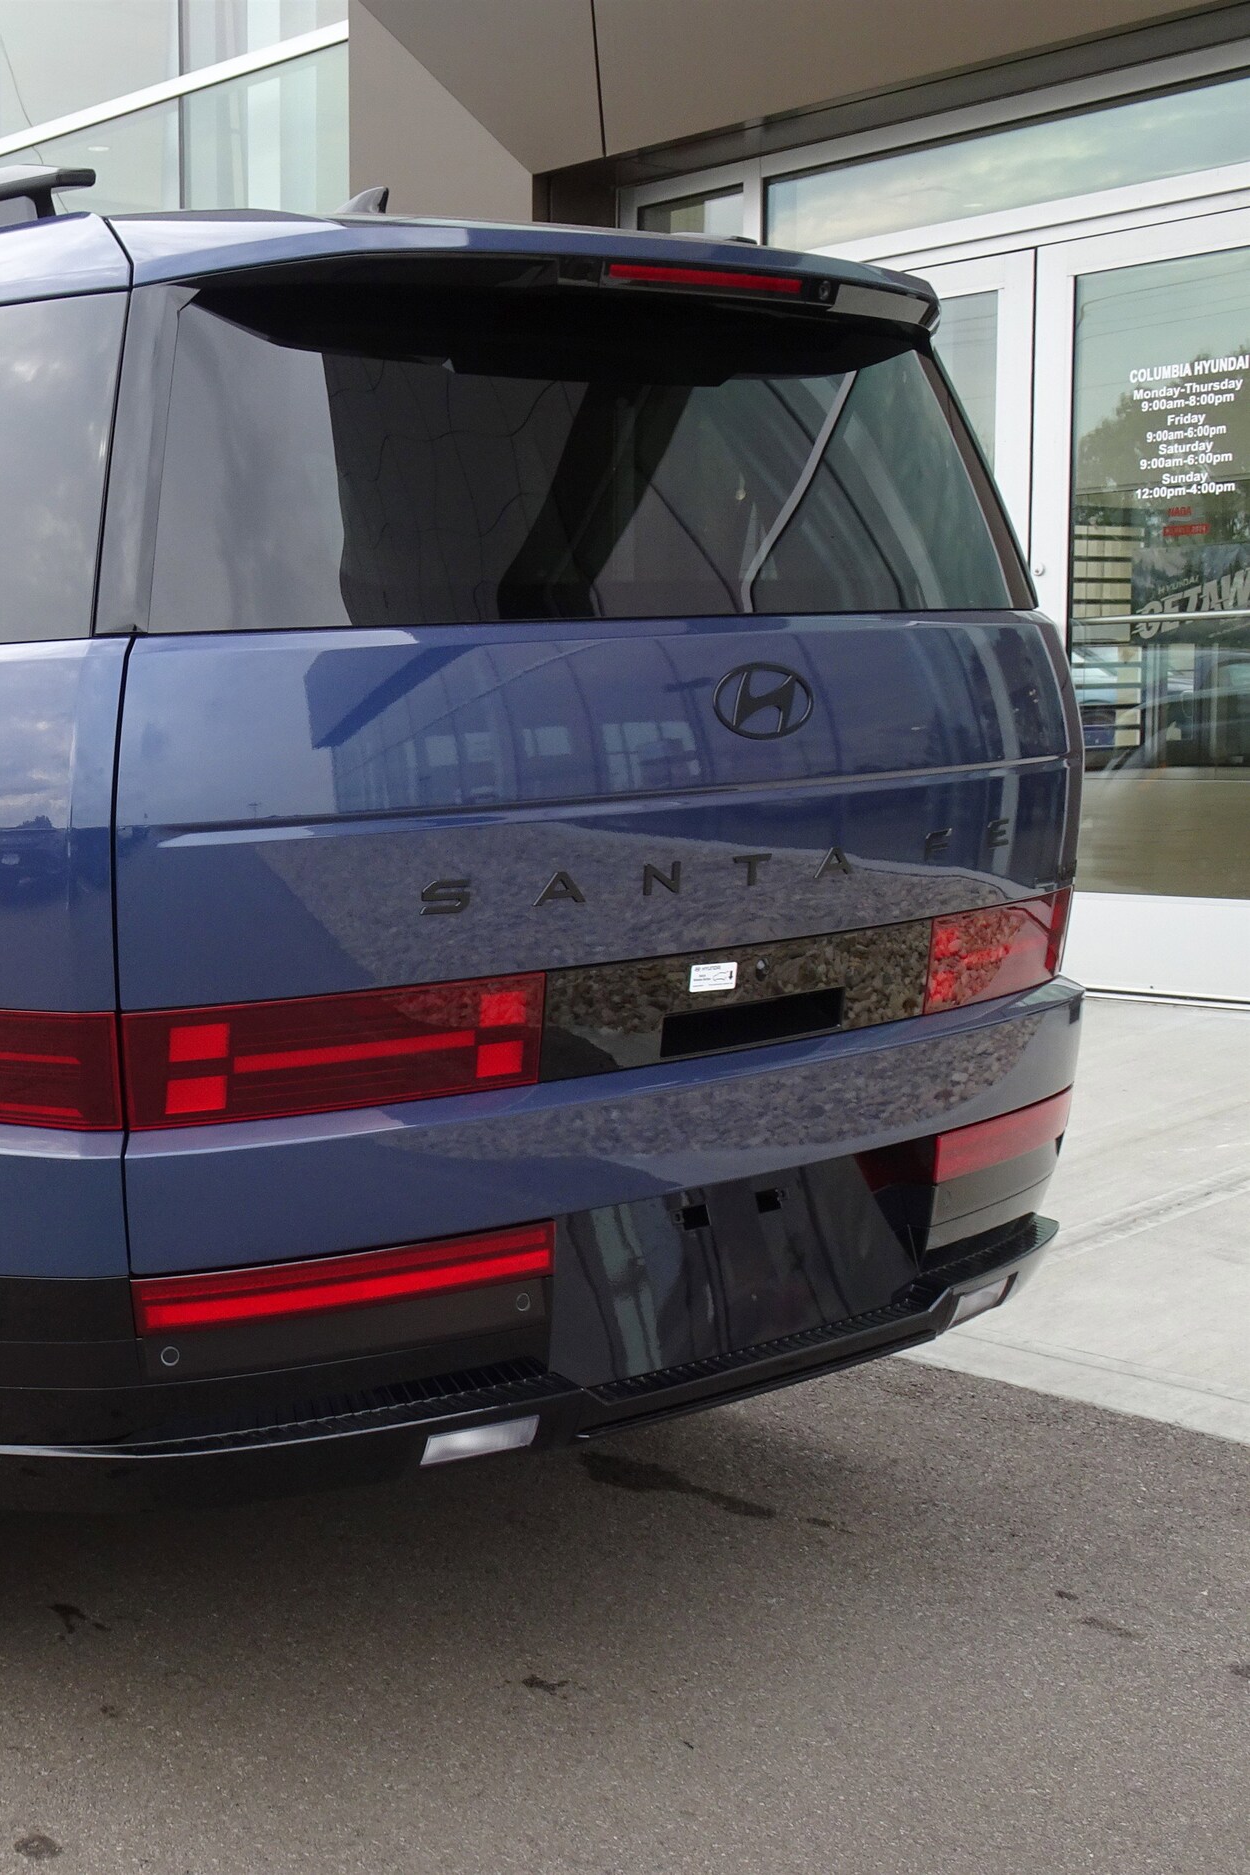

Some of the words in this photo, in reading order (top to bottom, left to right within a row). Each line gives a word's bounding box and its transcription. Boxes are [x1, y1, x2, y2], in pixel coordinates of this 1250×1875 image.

[1129, 364, 1192, 383] COLUMBIA
[1193, 355, 1250, 375] HYUNDAI
[1133, 378, 1244, 400] Monday-Thursday
[1141, 392, 1235, 412] 9:00am-8:00pm
[1167, 413, 1206, 426] Friday
[1146, 424, 1227, 443] 9:00am-6:00pm
[1158, 441, 1213, 455] Saturday
[1140, 452, 1233, 470] 9:00am-6:00pm
[1162, 471, 1209, 485] Sunday
[1136, 482, 1236, 499] 12:00pm-4:00pm
[1158, 575, 1200, 595] HYUNDAI
[419, 846, 852, 915] SANTA
[923, 818, 1012, 852] FE
